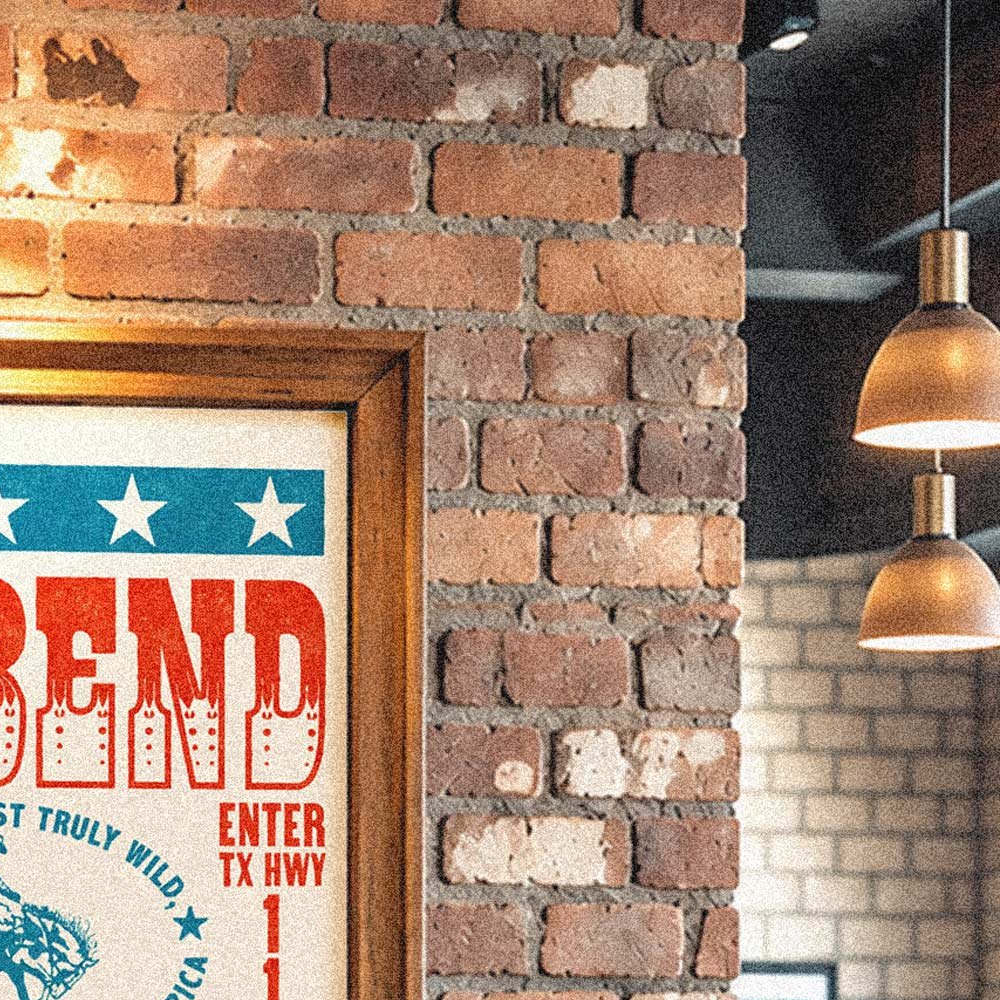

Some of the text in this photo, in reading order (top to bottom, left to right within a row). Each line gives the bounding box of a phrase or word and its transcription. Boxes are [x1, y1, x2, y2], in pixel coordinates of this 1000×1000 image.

[217, 800, 327, 848] ENTER
[38, 805, 121, 851] TRULY
[125, 839, 184, 909] WILD,
[217, 850, 328, 888] TX HWY
